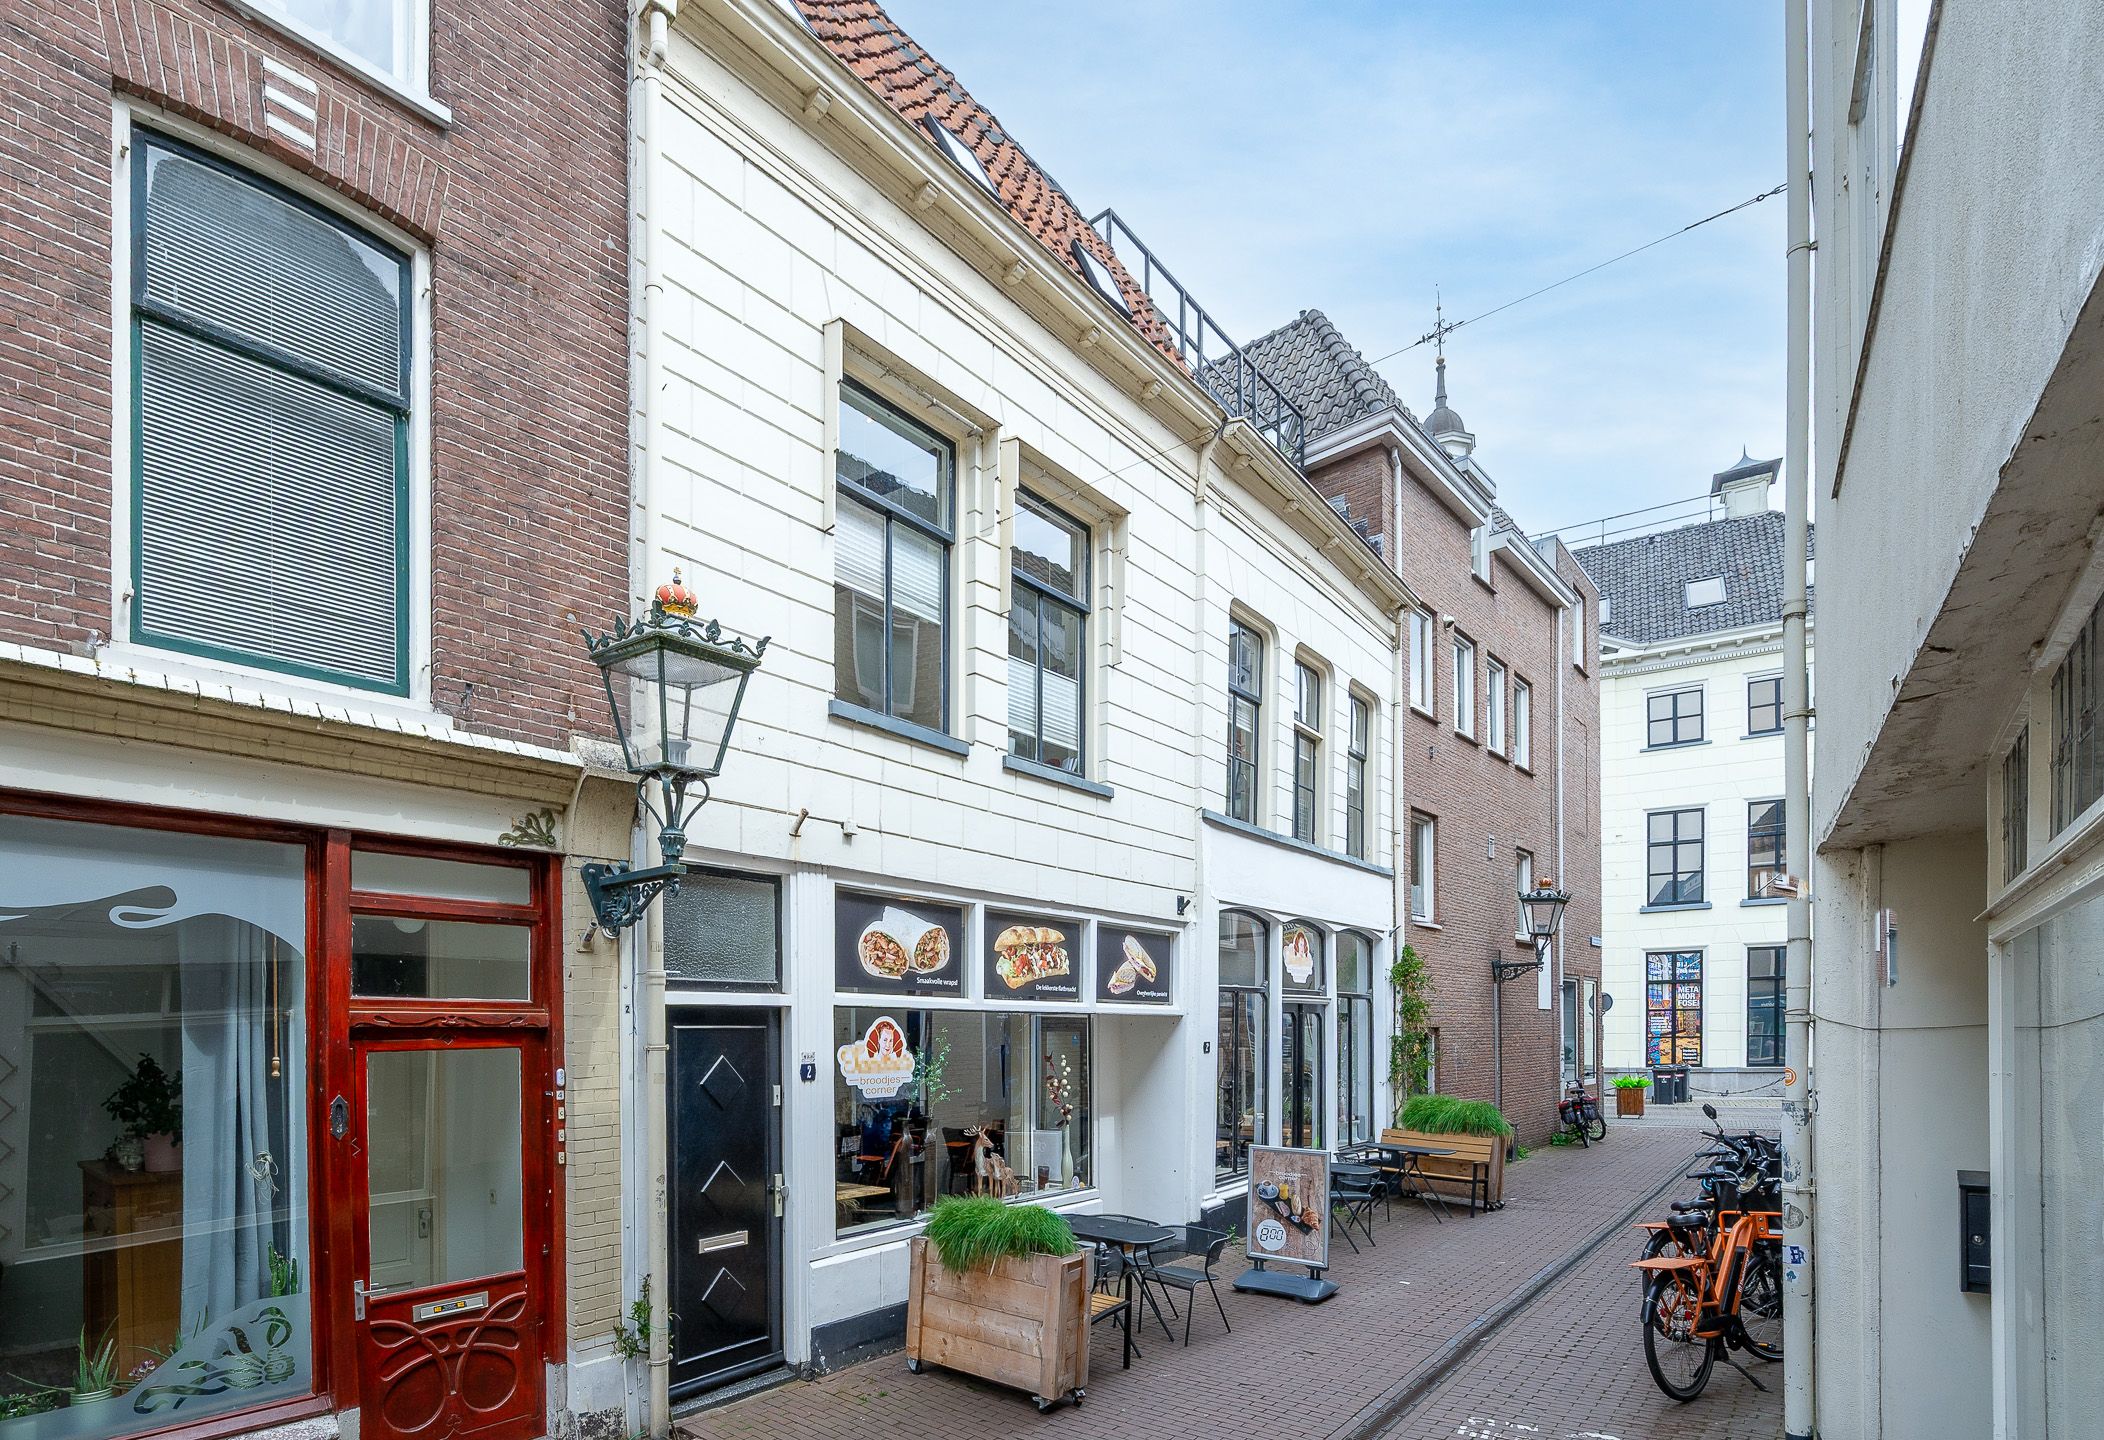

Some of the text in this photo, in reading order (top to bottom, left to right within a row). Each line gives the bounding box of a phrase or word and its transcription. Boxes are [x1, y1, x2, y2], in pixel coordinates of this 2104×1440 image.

[625, 1005, 630, 1014] 2
[806, 1065, 812, 1079] 2
[860, 1076, 901, 1086] broodjes
[865, 1086, 896, 1095] corner
